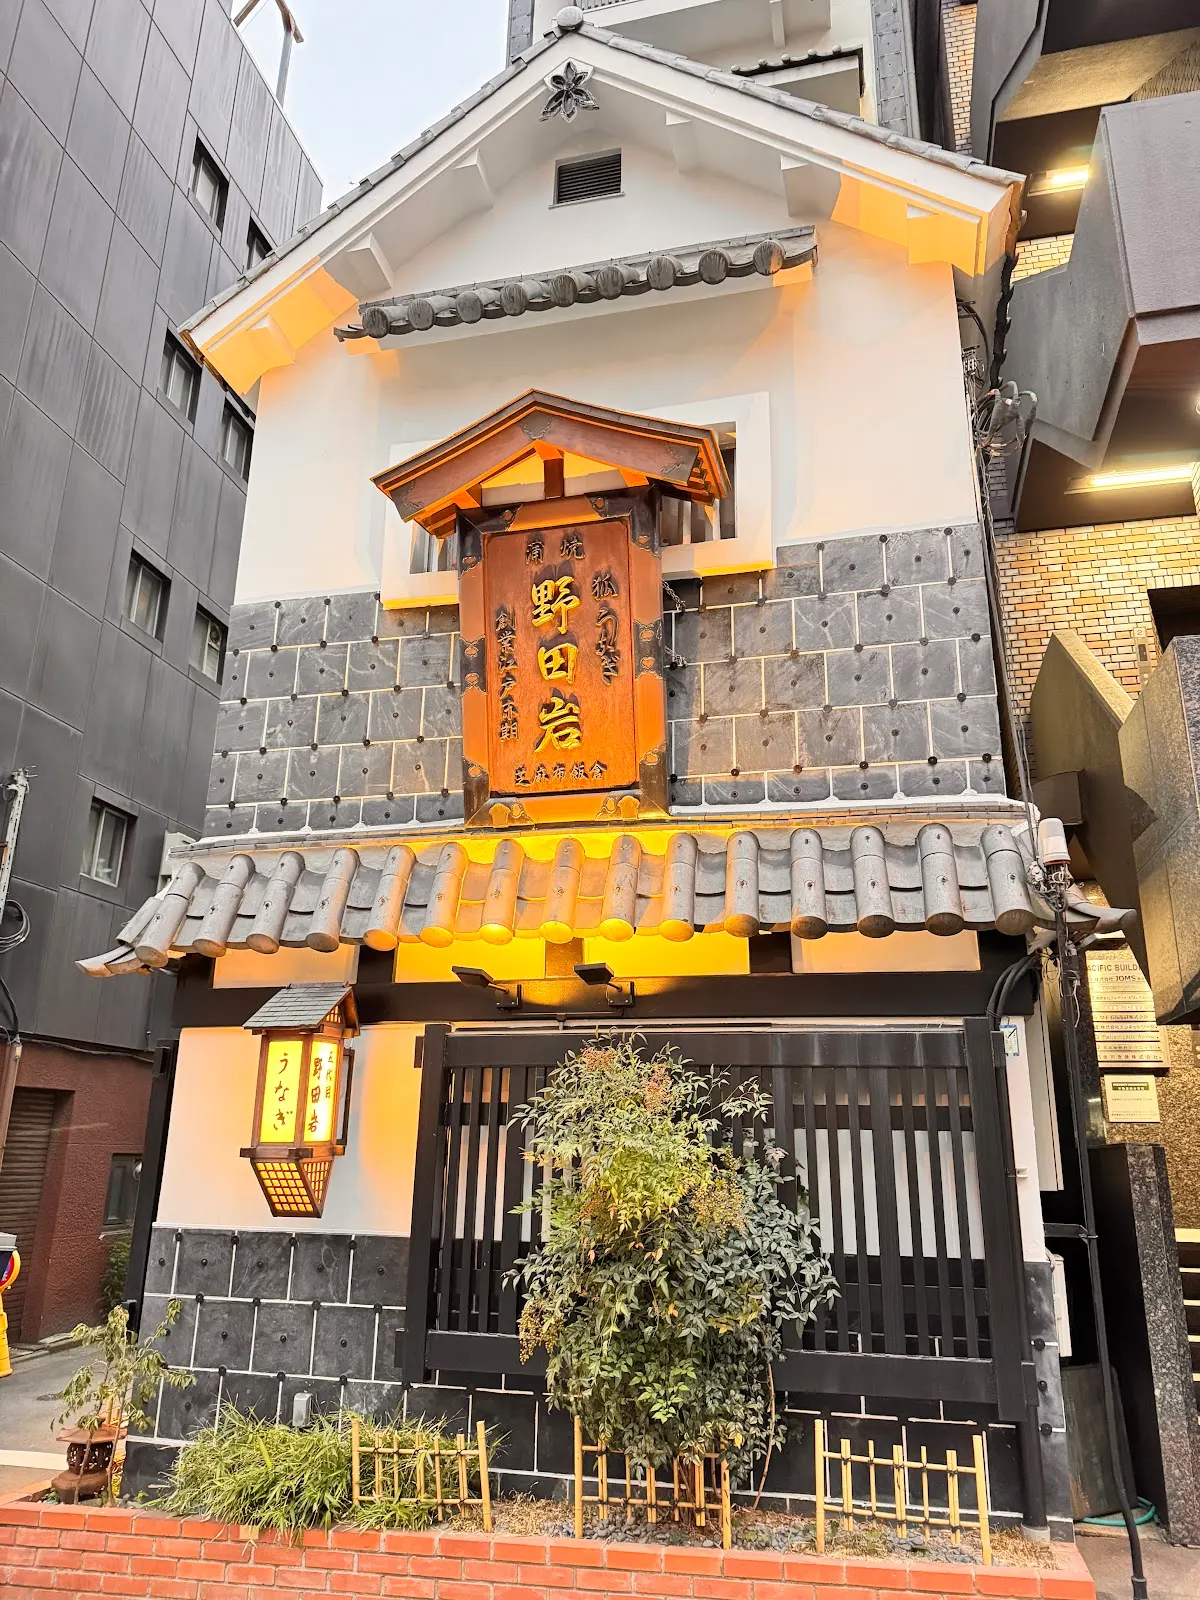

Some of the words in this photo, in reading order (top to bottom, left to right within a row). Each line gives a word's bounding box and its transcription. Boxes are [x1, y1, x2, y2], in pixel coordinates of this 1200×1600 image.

[531, 575, 582, 752] 野田岩
[1114, 963, 1140, 971] BUILD
[273, 1053, 293, 1131] うなぎ
[308, 1057, 323, 1133] 野田岩
